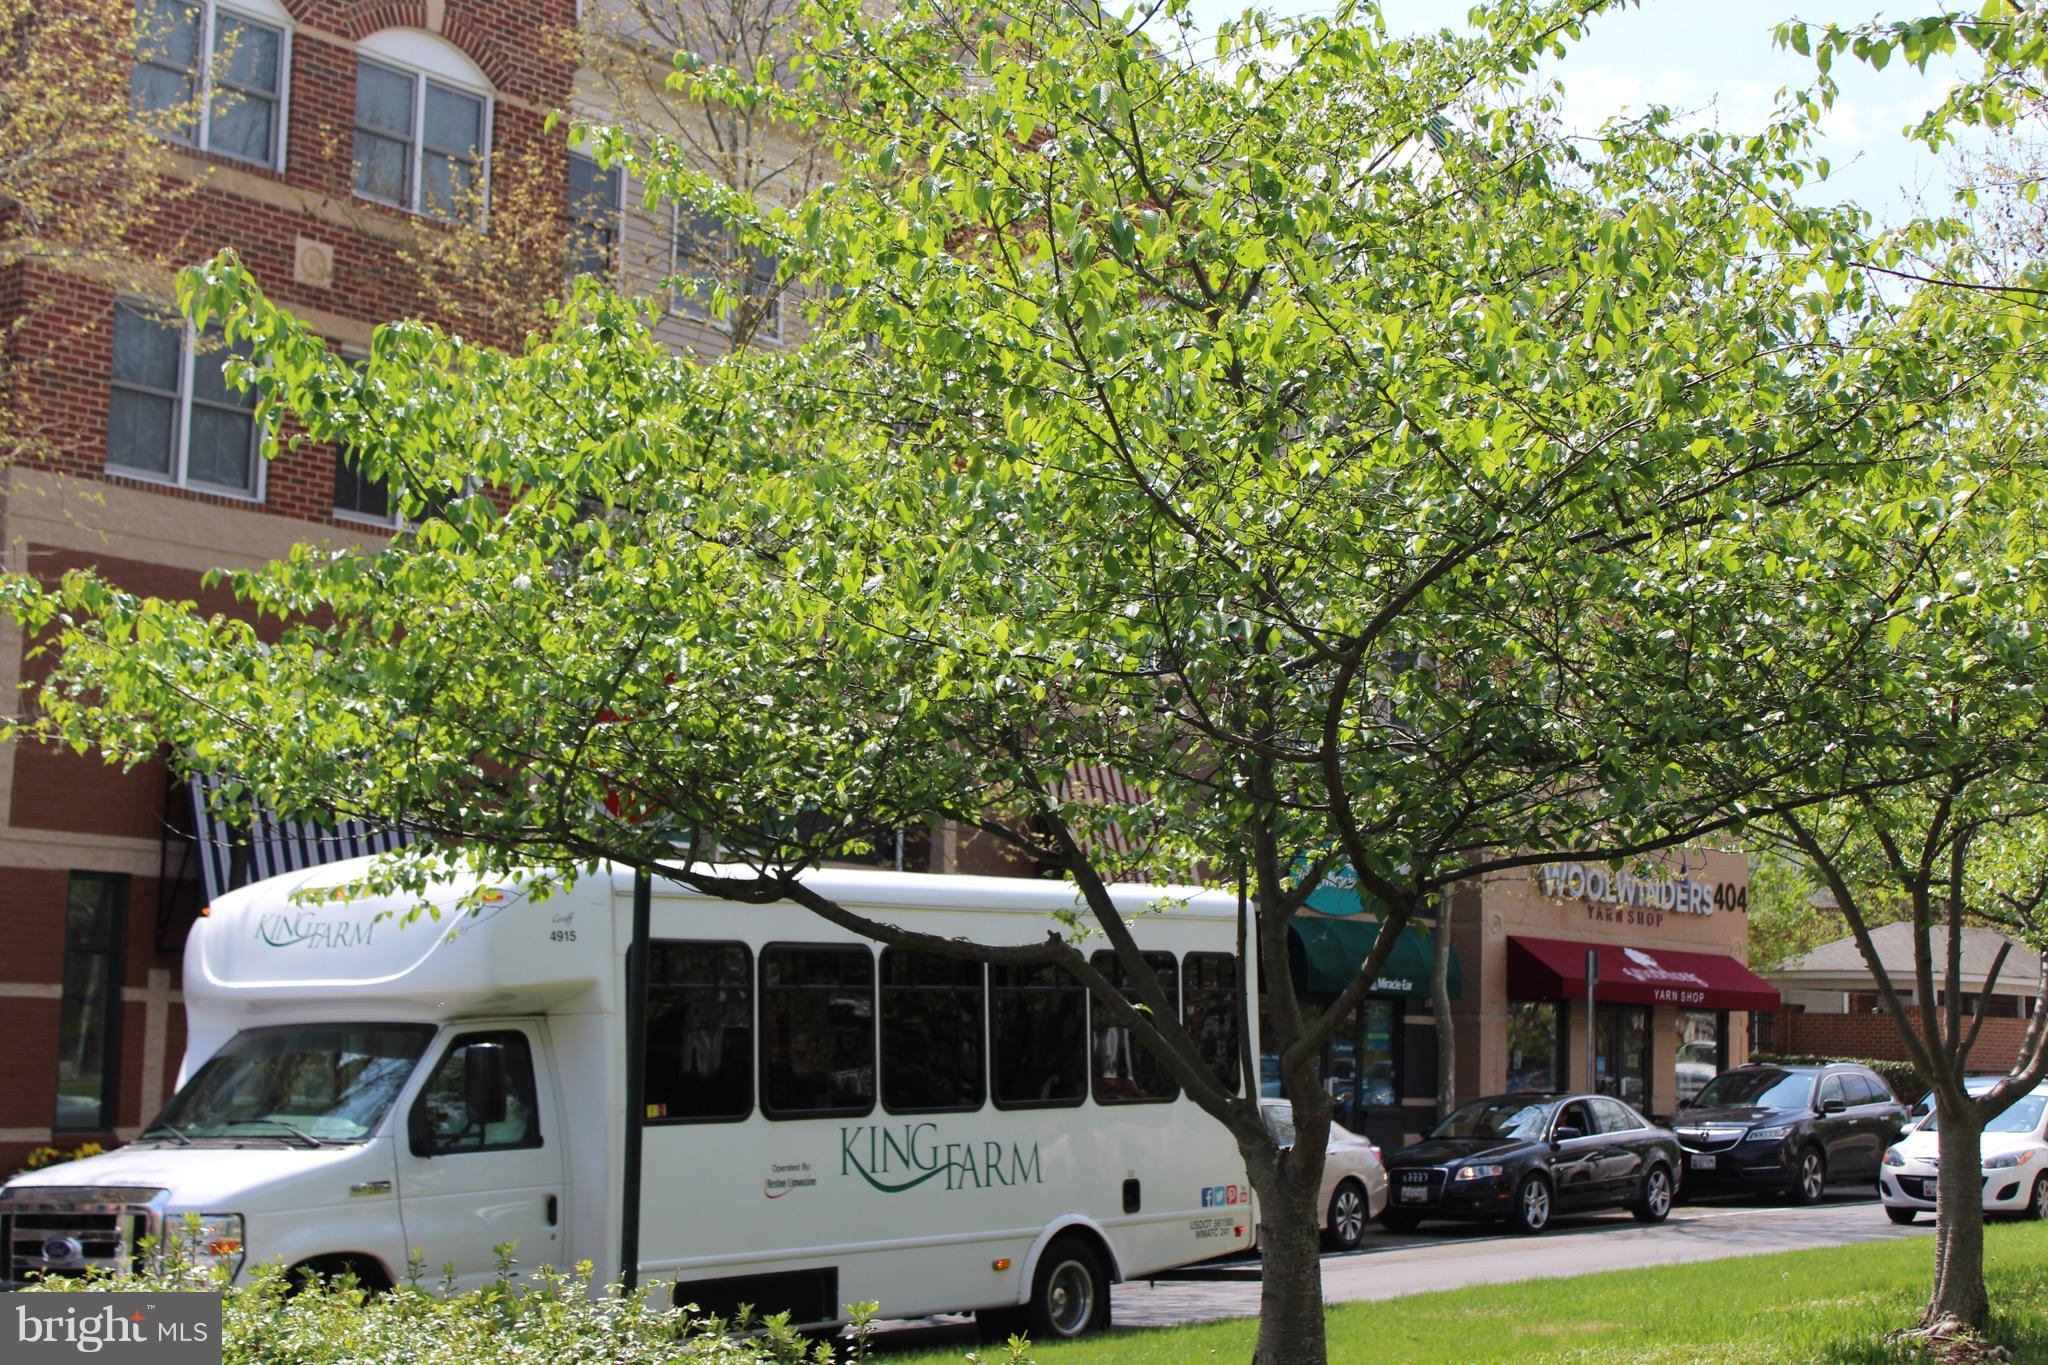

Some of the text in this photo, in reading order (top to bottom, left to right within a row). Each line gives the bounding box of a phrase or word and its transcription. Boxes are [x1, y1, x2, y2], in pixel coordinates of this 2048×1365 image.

[1714, 882, 1747, 913] 404
[1587, 903, 1663, 927] YARN SHOP
[550, 930, 576, 942] 4915
[1654, 989, 1705, 1004] YARN SHOP
